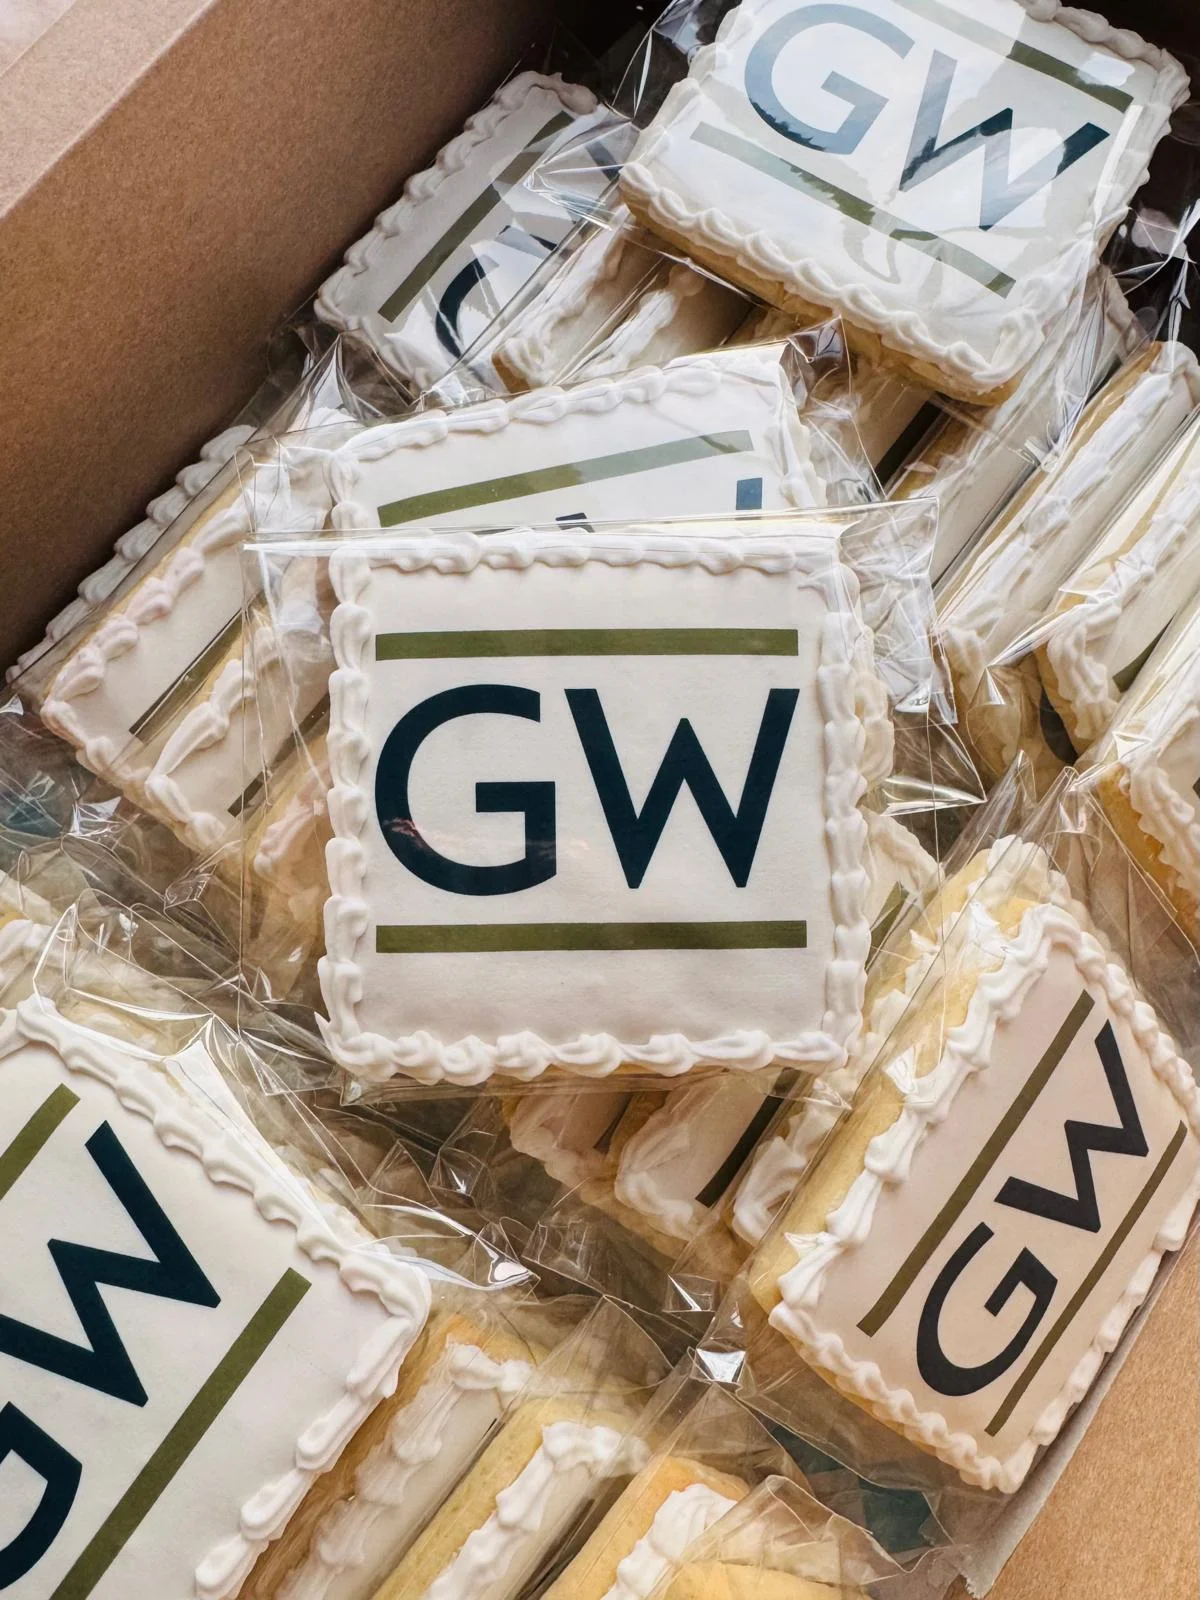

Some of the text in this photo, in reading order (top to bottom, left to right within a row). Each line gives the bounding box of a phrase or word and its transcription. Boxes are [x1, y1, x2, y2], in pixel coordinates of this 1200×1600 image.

[744, 3, 1110, 231] GW
[375, 684, 800, 896] GW
[916, 1019, 1149, 1396] GW
